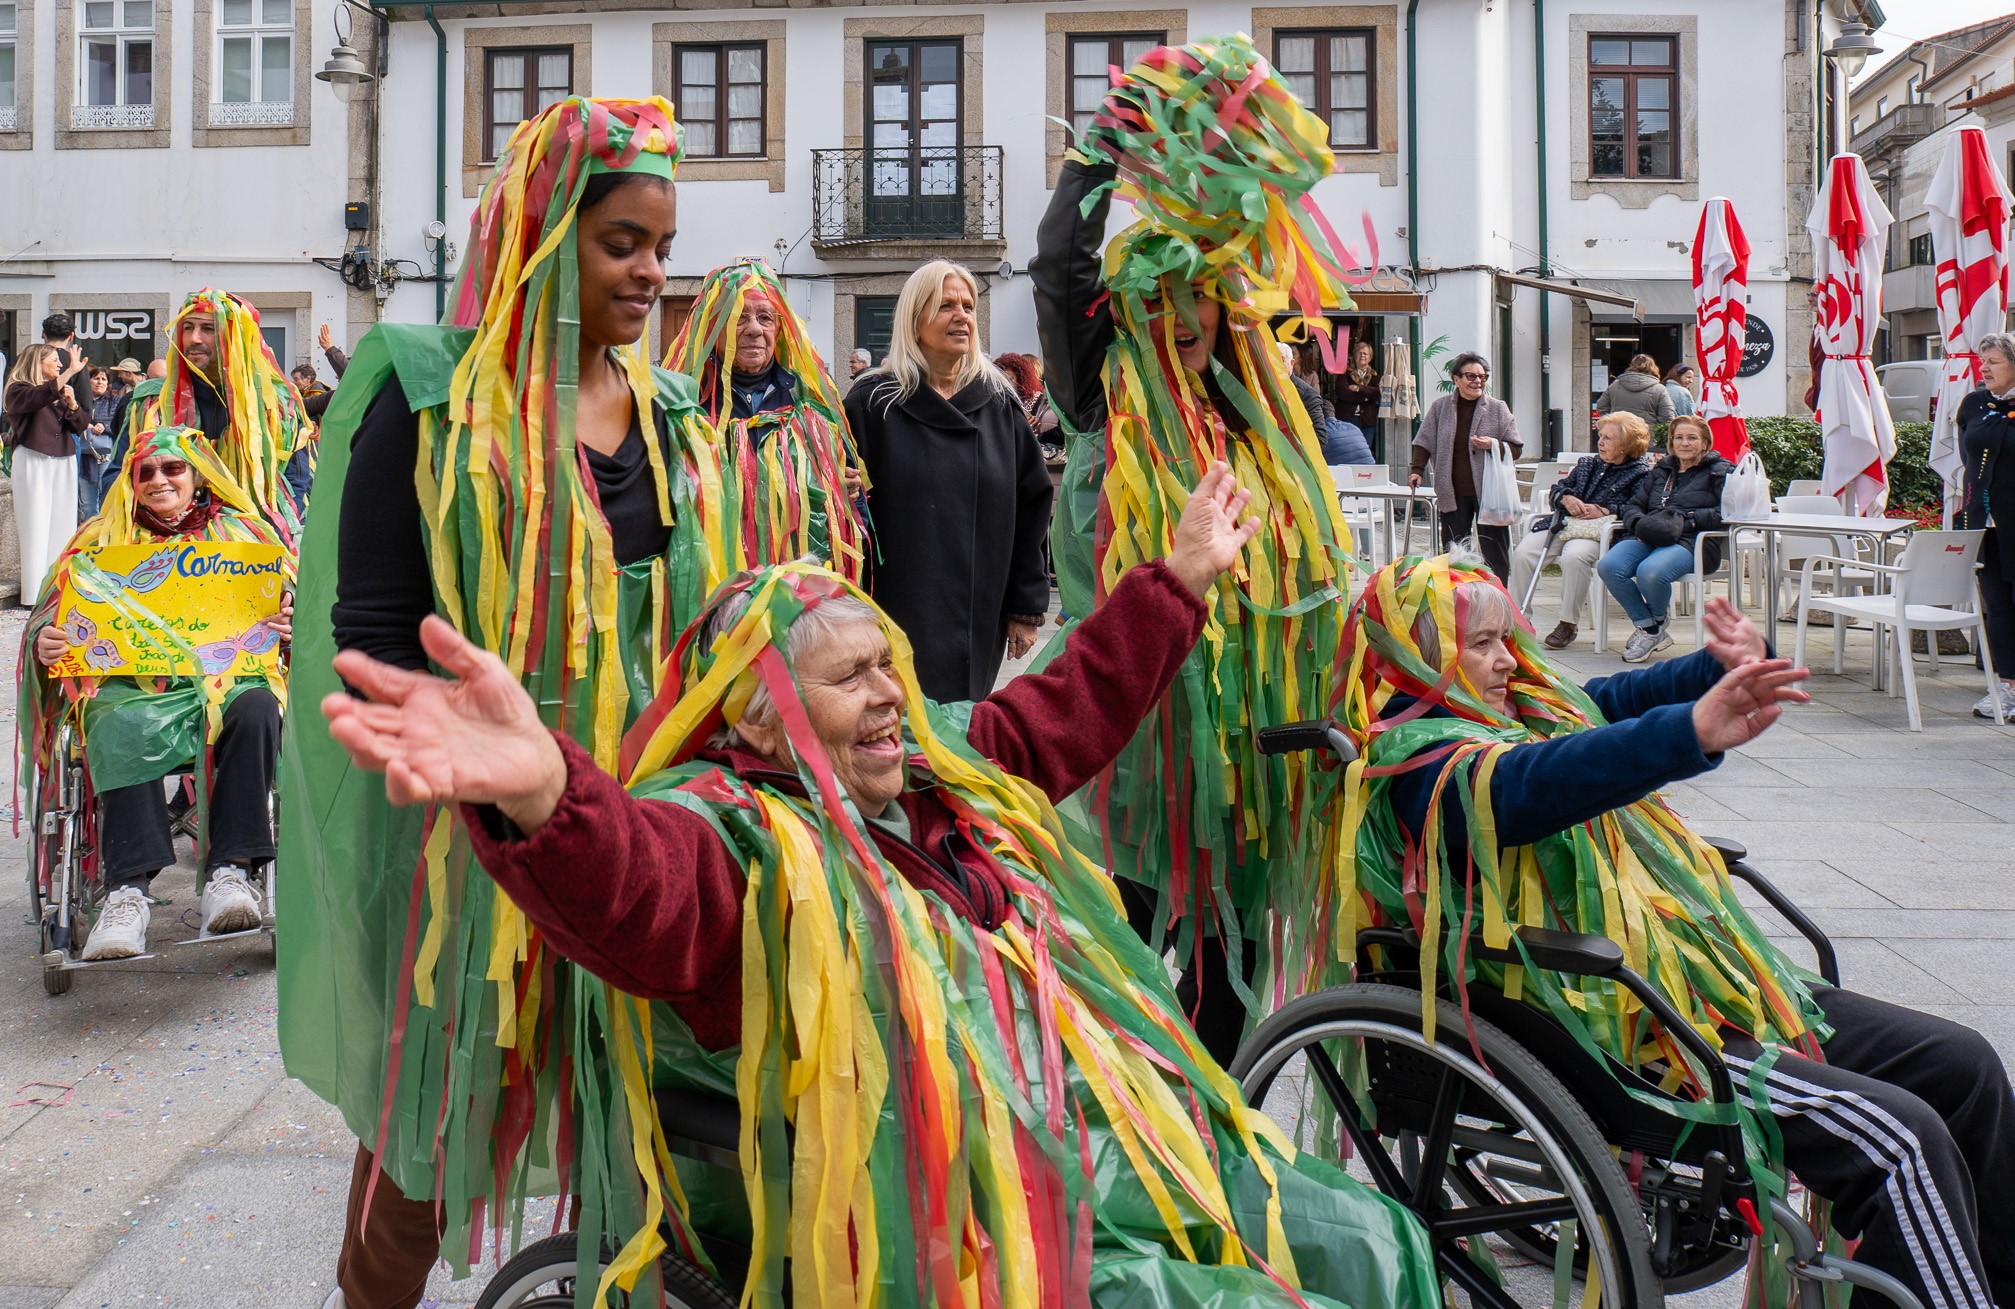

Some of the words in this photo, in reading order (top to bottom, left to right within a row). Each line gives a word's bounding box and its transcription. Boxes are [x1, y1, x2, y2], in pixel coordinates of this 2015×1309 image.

[177, 545, 283, 577] Carnaval
[111, 615, 184, 631] Careos
[134, 663, 168, 674] Deus
